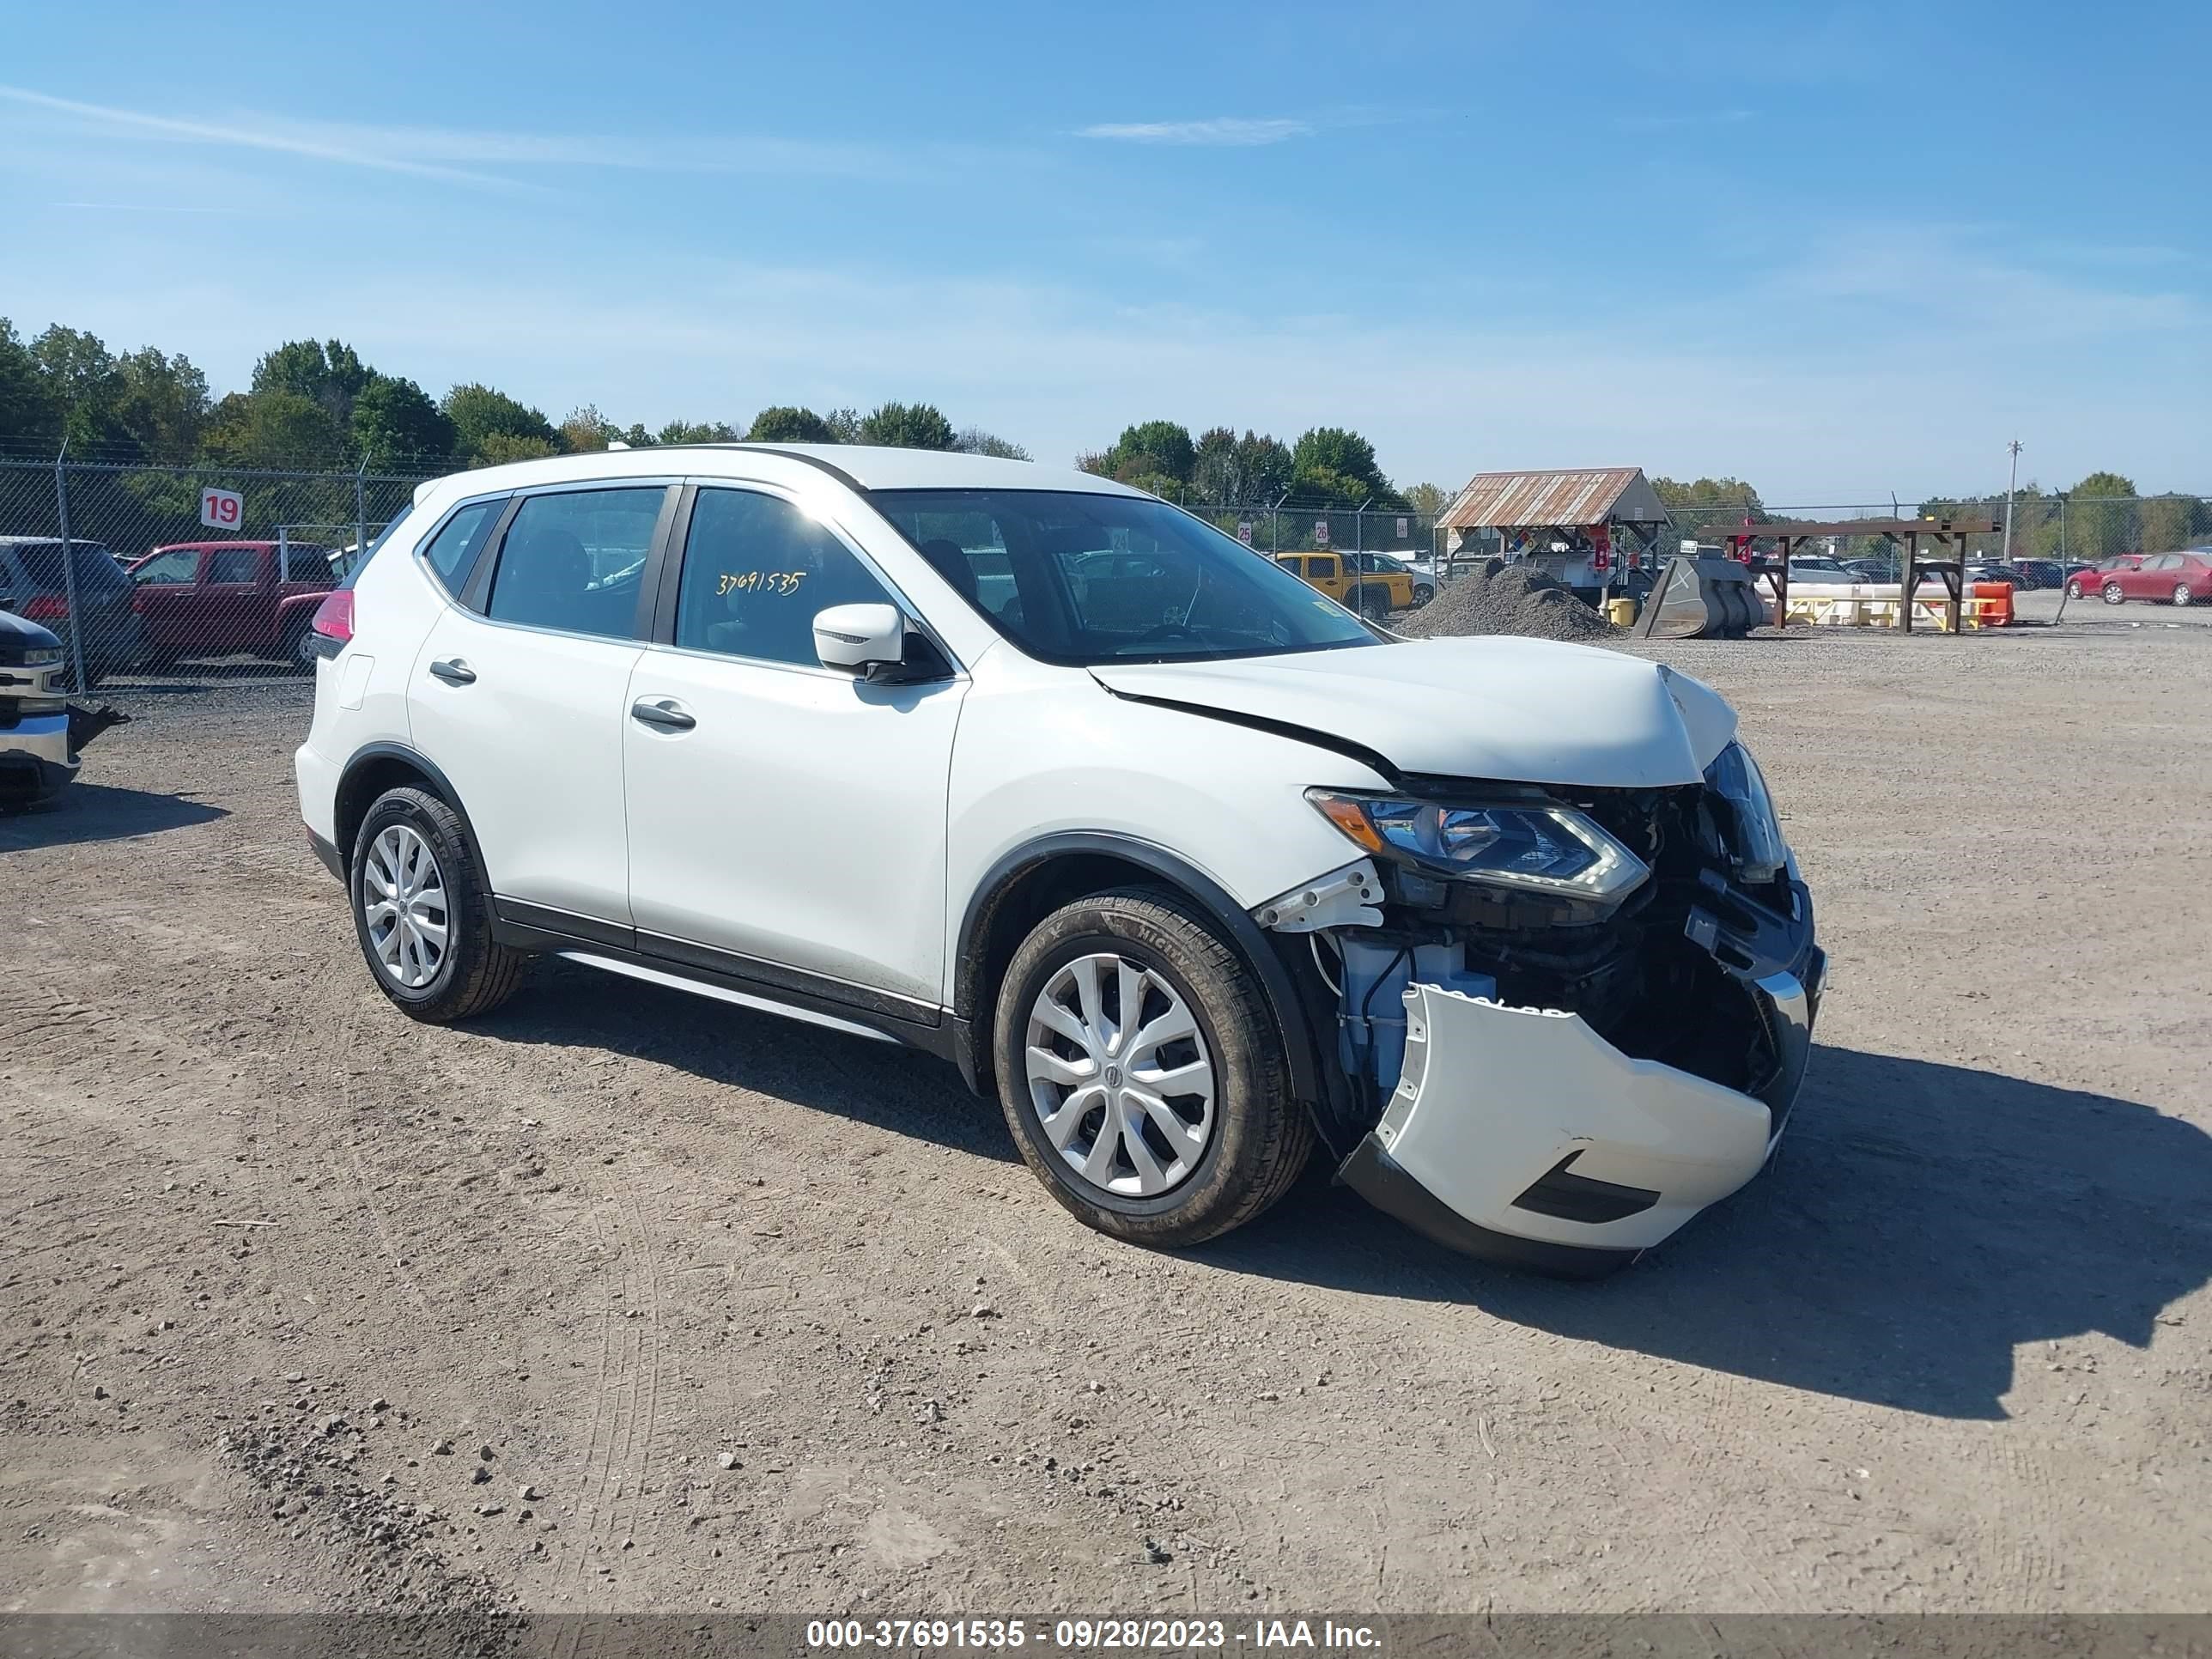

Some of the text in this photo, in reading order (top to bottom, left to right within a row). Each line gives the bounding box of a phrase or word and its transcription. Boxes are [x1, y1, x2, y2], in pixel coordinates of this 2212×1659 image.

[206, 495, 239, 523] 19
[1239, 527, 1250, 541] 25
[1316, 526, 1327, 539] 26
[715, 571, 807, 597] 37691535
[1138, 925, 1190, 967] HICITY
